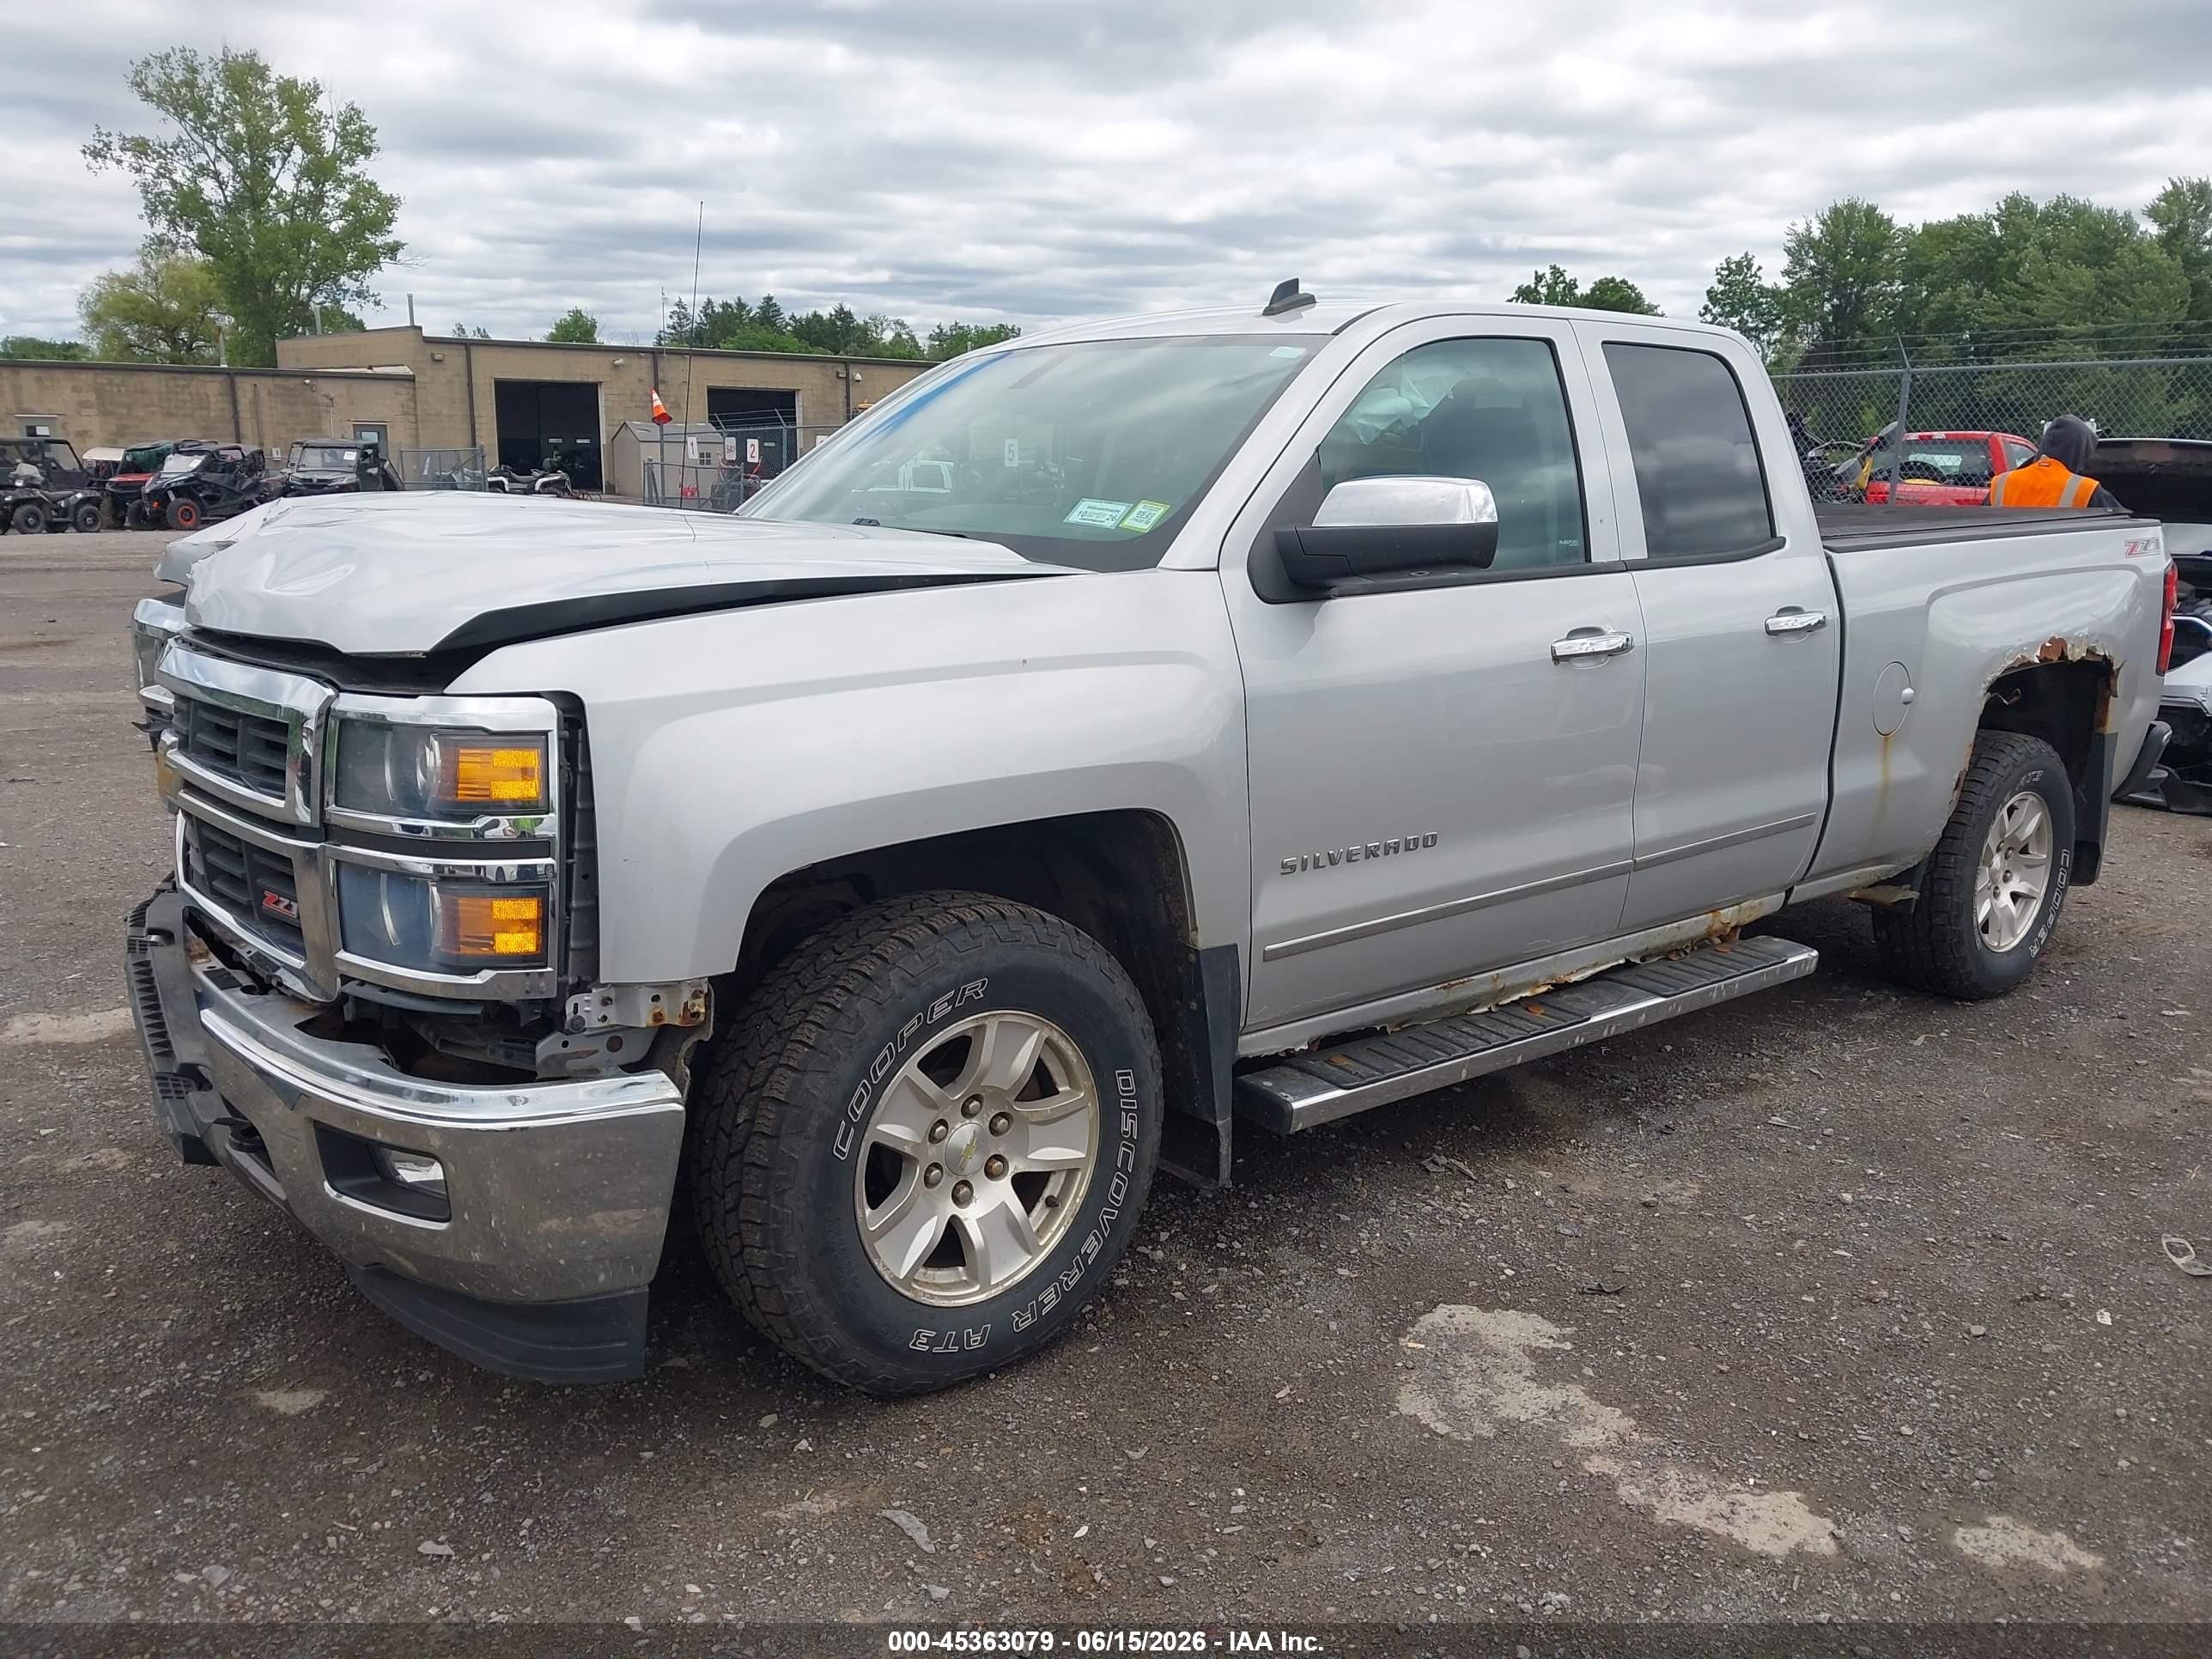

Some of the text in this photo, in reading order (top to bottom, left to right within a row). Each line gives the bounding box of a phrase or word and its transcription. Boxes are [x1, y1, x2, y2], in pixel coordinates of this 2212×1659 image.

[750, 443, 757, 459] 2
[1008, 443, 1015, 462] 5
[2124, 538, 2160, 558] Z71
[1280, 831, 1438, 875] SILVERADO
[262, 890, 298, 919] Z71
[2028, 848, 2070, 959] COOPER
[833, 977, 988, 1160] COOPER
[908, 1069, 1138, 1353] DISCOVERER AT3
